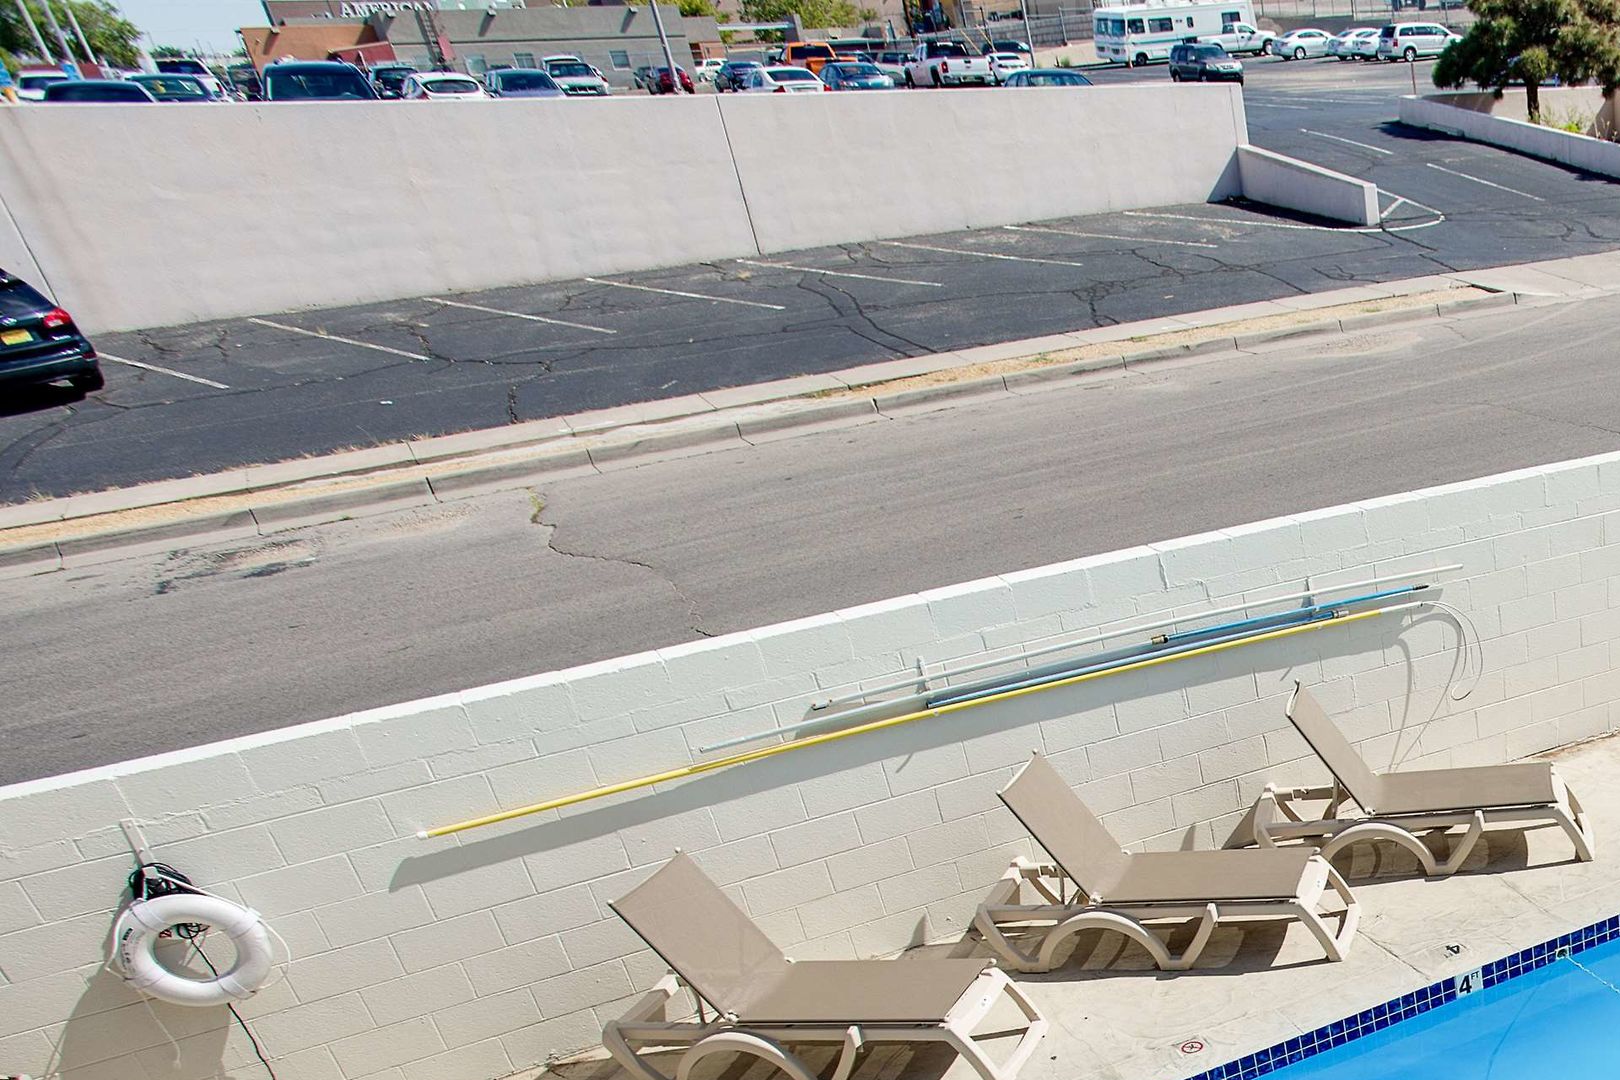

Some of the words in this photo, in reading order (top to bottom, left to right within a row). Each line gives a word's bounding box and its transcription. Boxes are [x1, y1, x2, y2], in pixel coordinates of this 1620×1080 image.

[1445, 945, 1460, 955] 4
[1459, 975, 1472, 994] 4
[1471, 971, 1480, 980] FT
